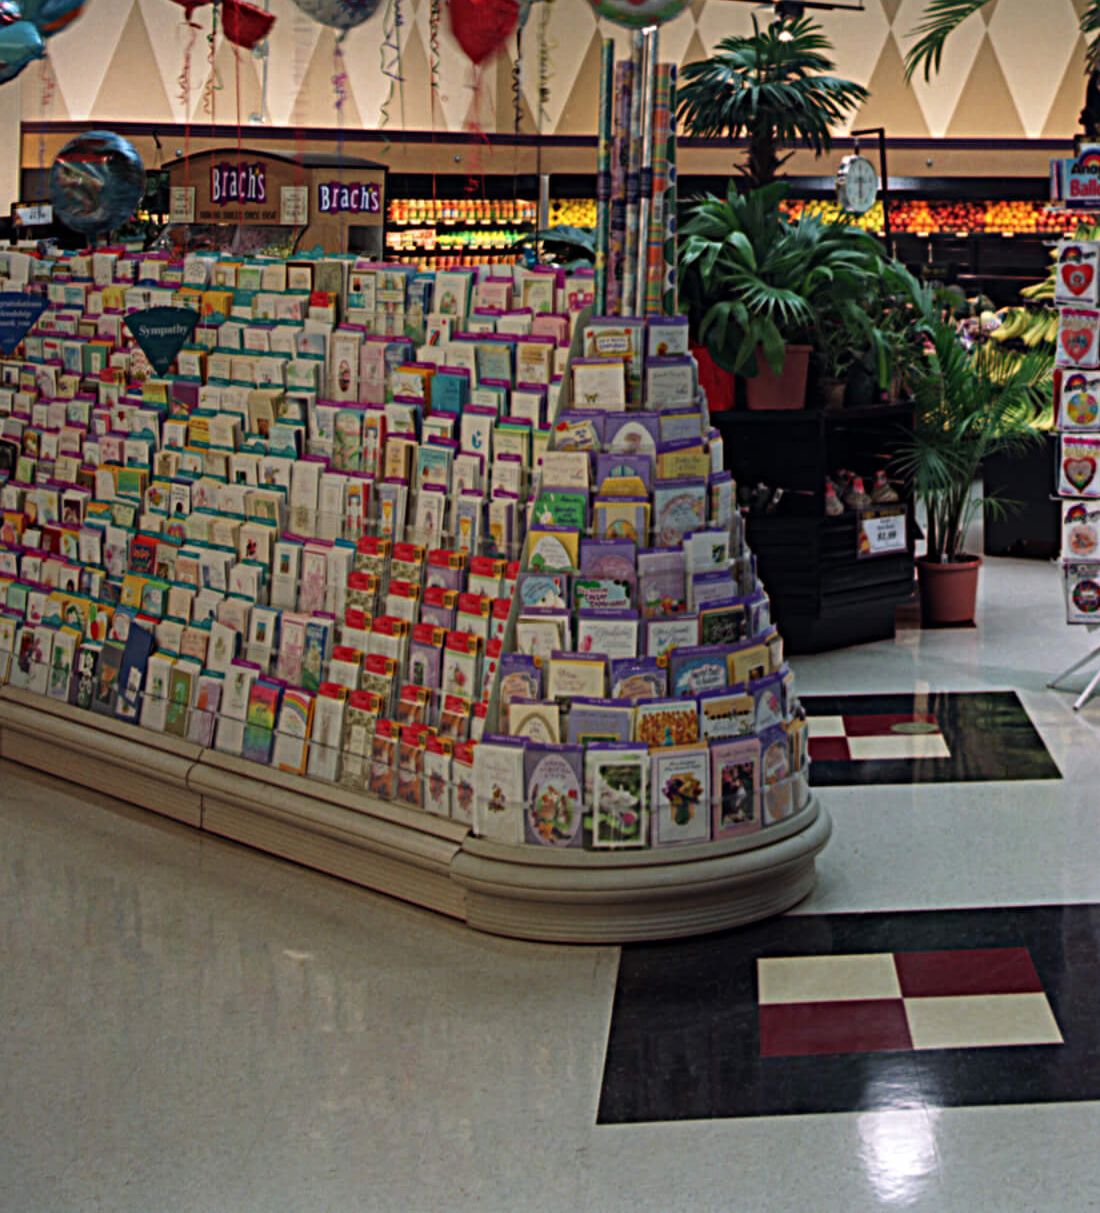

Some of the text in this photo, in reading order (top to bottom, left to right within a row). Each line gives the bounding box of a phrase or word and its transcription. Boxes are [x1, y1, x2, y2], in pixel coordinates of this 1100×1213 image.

[212, 166, 265, 202] Brach's
[321, 184, 380, 212] Brach's
[138, 323, 189, 337] Sympathy
